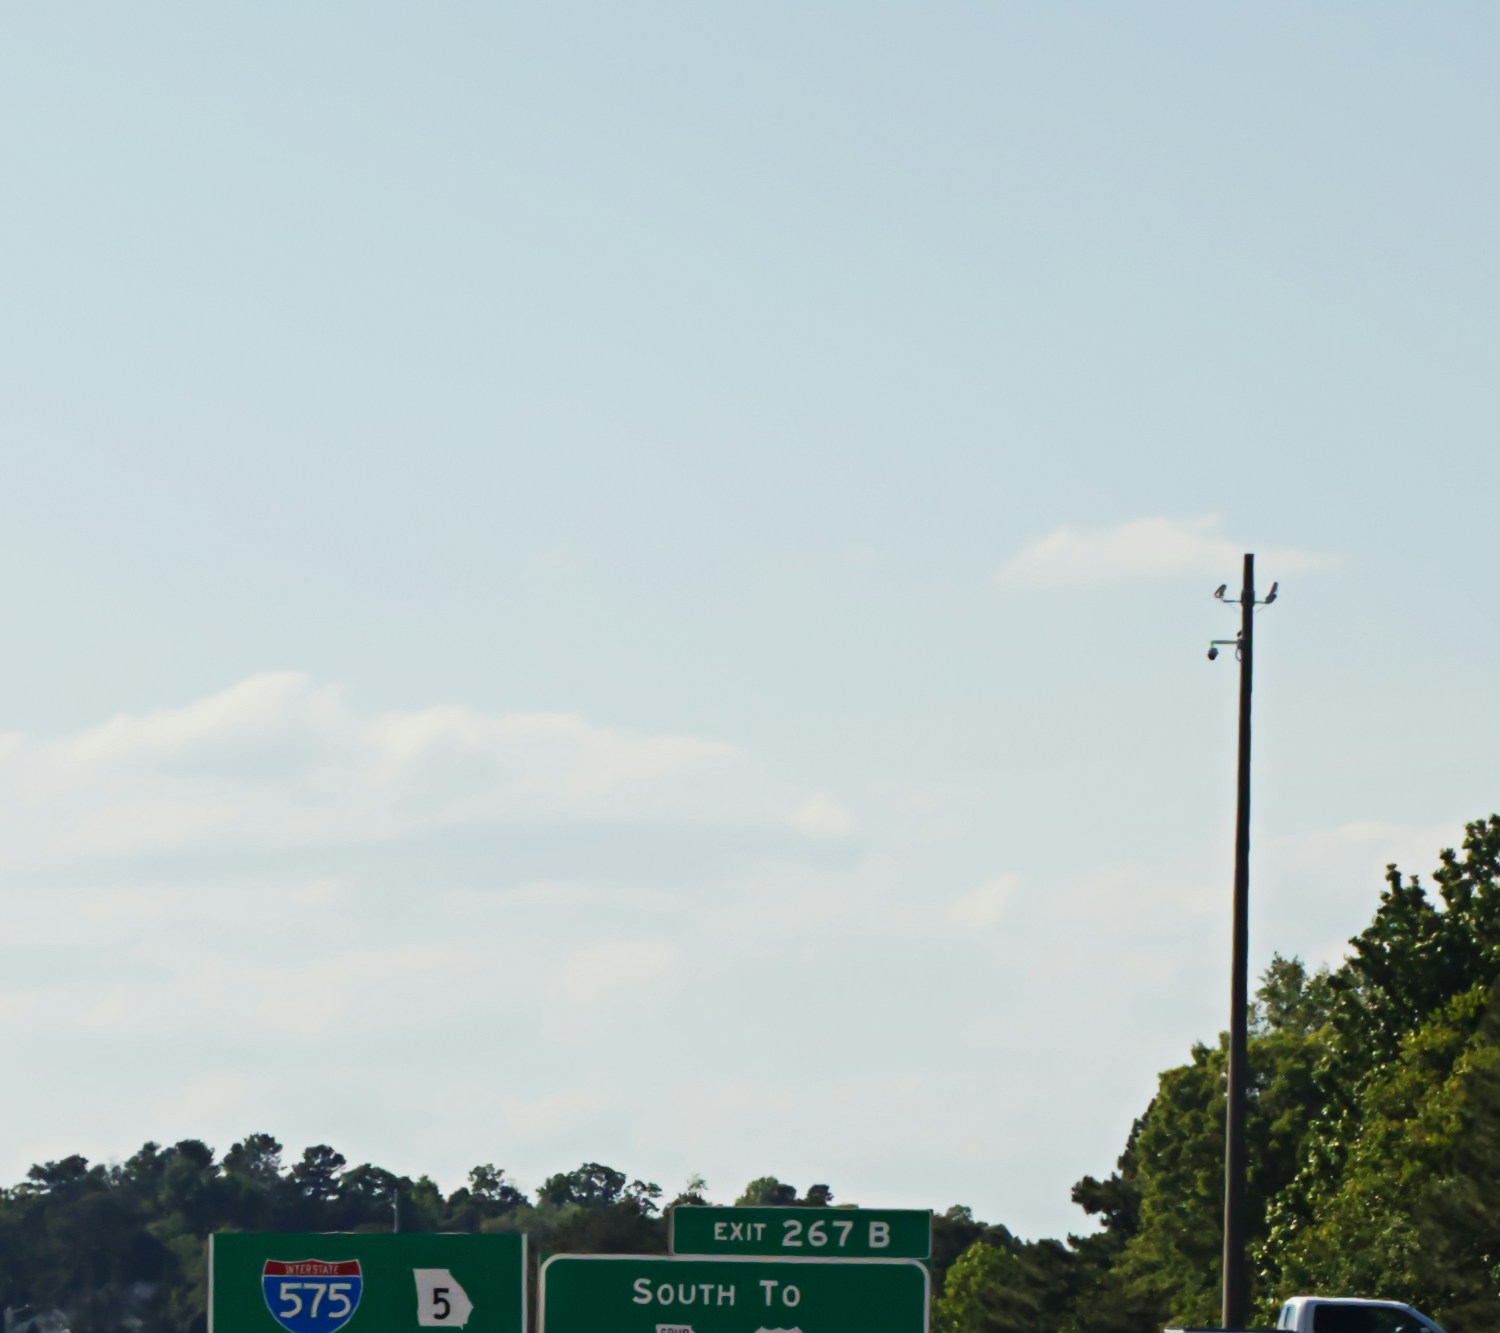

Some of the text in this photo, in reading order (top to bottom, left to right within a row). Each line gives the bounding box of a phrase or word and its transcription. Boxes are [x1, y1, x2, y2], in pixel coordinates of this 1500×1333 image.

[714, 1221, 891, 1247] EXIT 267 B
[285, 1263, 338, 1275] INTERSTATE
[279, 1283, 352, 1319] 575
[433, 1287, 451, 1320] 5
